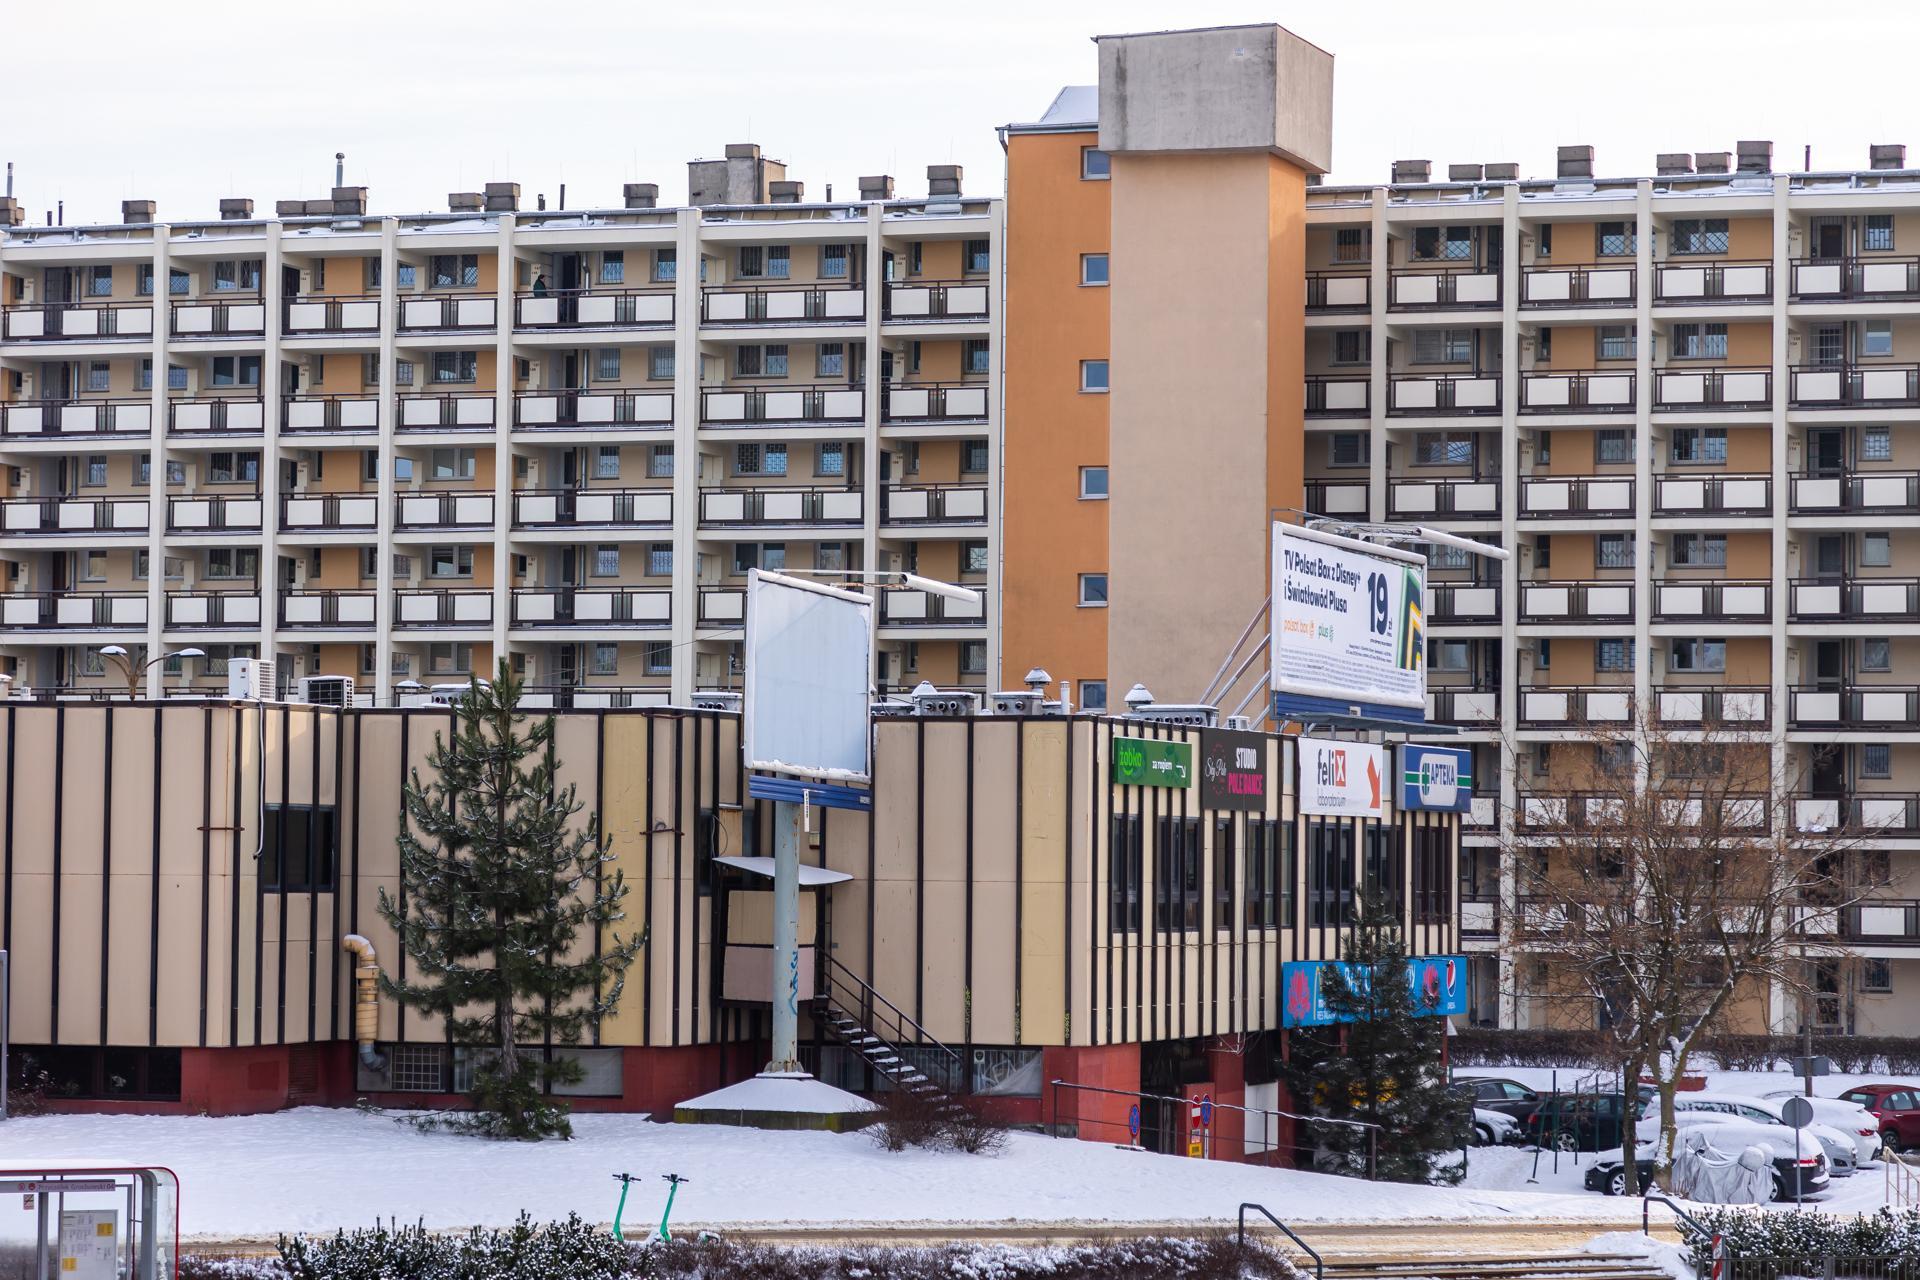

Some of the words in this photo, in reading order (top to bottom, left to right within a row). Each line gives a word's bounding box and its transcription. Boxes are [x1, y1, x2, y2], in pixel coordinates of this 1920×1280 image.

[1284, 549, 1294, 571] TV
[1295, 551, 1317, 577] Polsat
[1318, 557, 1331, 580] Box
[1332, 566, 1336, 581] z
[1284, 579, 1287, 600] i
[1287, 574, 1329, 609] Światłowód
[1329, 590, 1348, 613] Plusa
[1367, 571, 1389, 636] 19
[1318, 622, 1329, 639] plus
[1236, 747, 1257, 770] STUDIO
[1431, 763, 1456, 786] APTEKA
